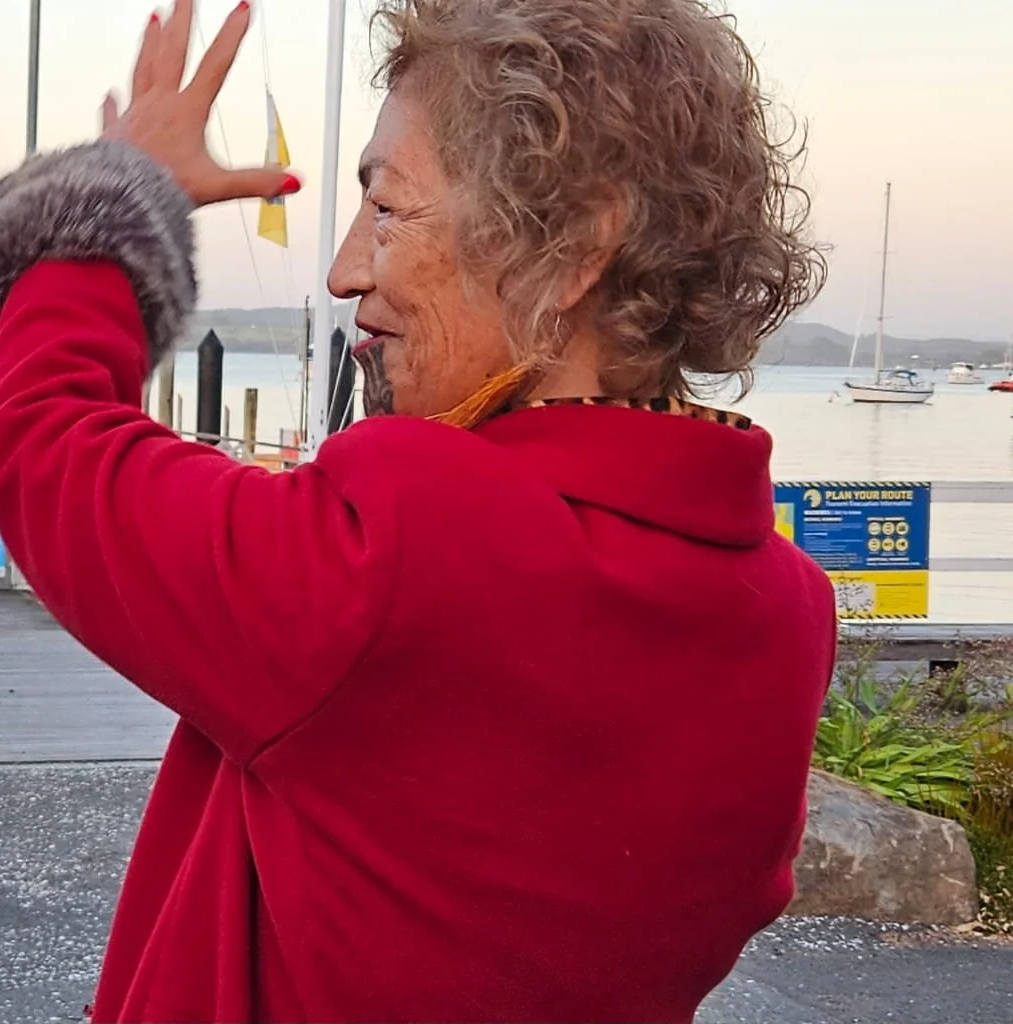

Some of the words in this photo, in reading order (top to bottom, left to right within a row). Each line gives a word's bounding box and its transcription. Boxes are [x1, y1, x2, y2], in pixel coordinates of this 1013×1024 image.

[826, 491, 852, 500] PLAN
[853, 491, 880, 500] YOUR
[881, 491, 913, 500] ROUTE
